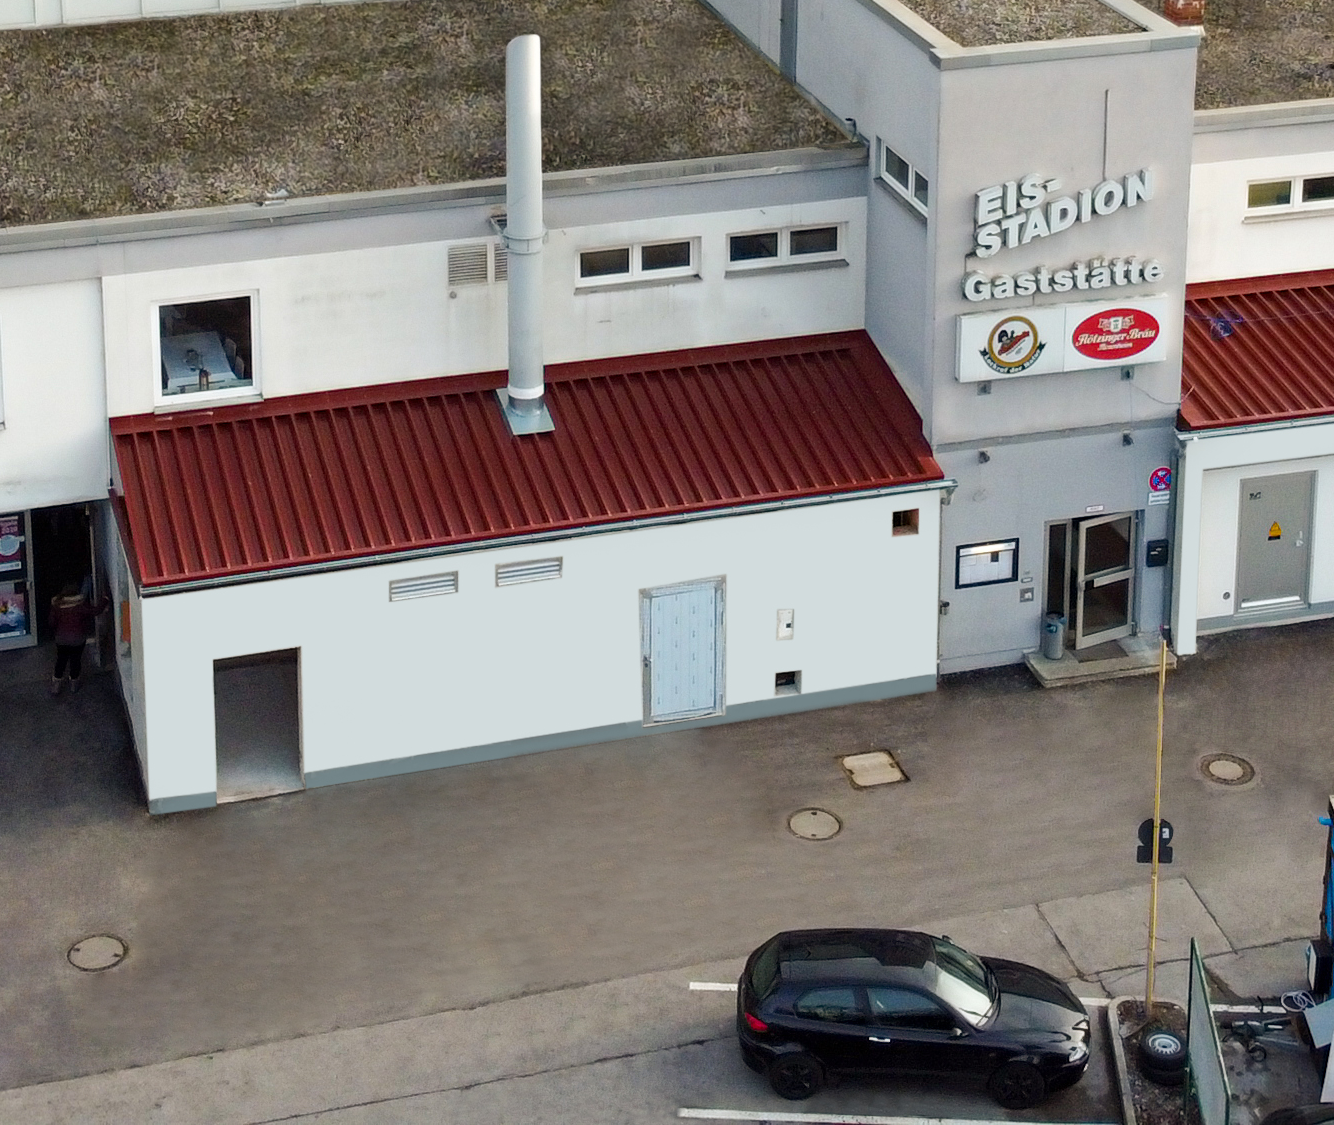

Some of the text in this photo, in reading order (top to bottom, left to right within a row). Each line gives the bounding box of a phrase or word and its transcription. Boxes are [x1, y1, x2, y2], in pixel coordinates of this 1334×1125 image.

[974, 166, 1155, 259] STADION
[975, 172, 1063, 226] EIS-
[963, 255, 1165, 302] Gaststätte
[1127, 327, 1156, 341] Bräu
